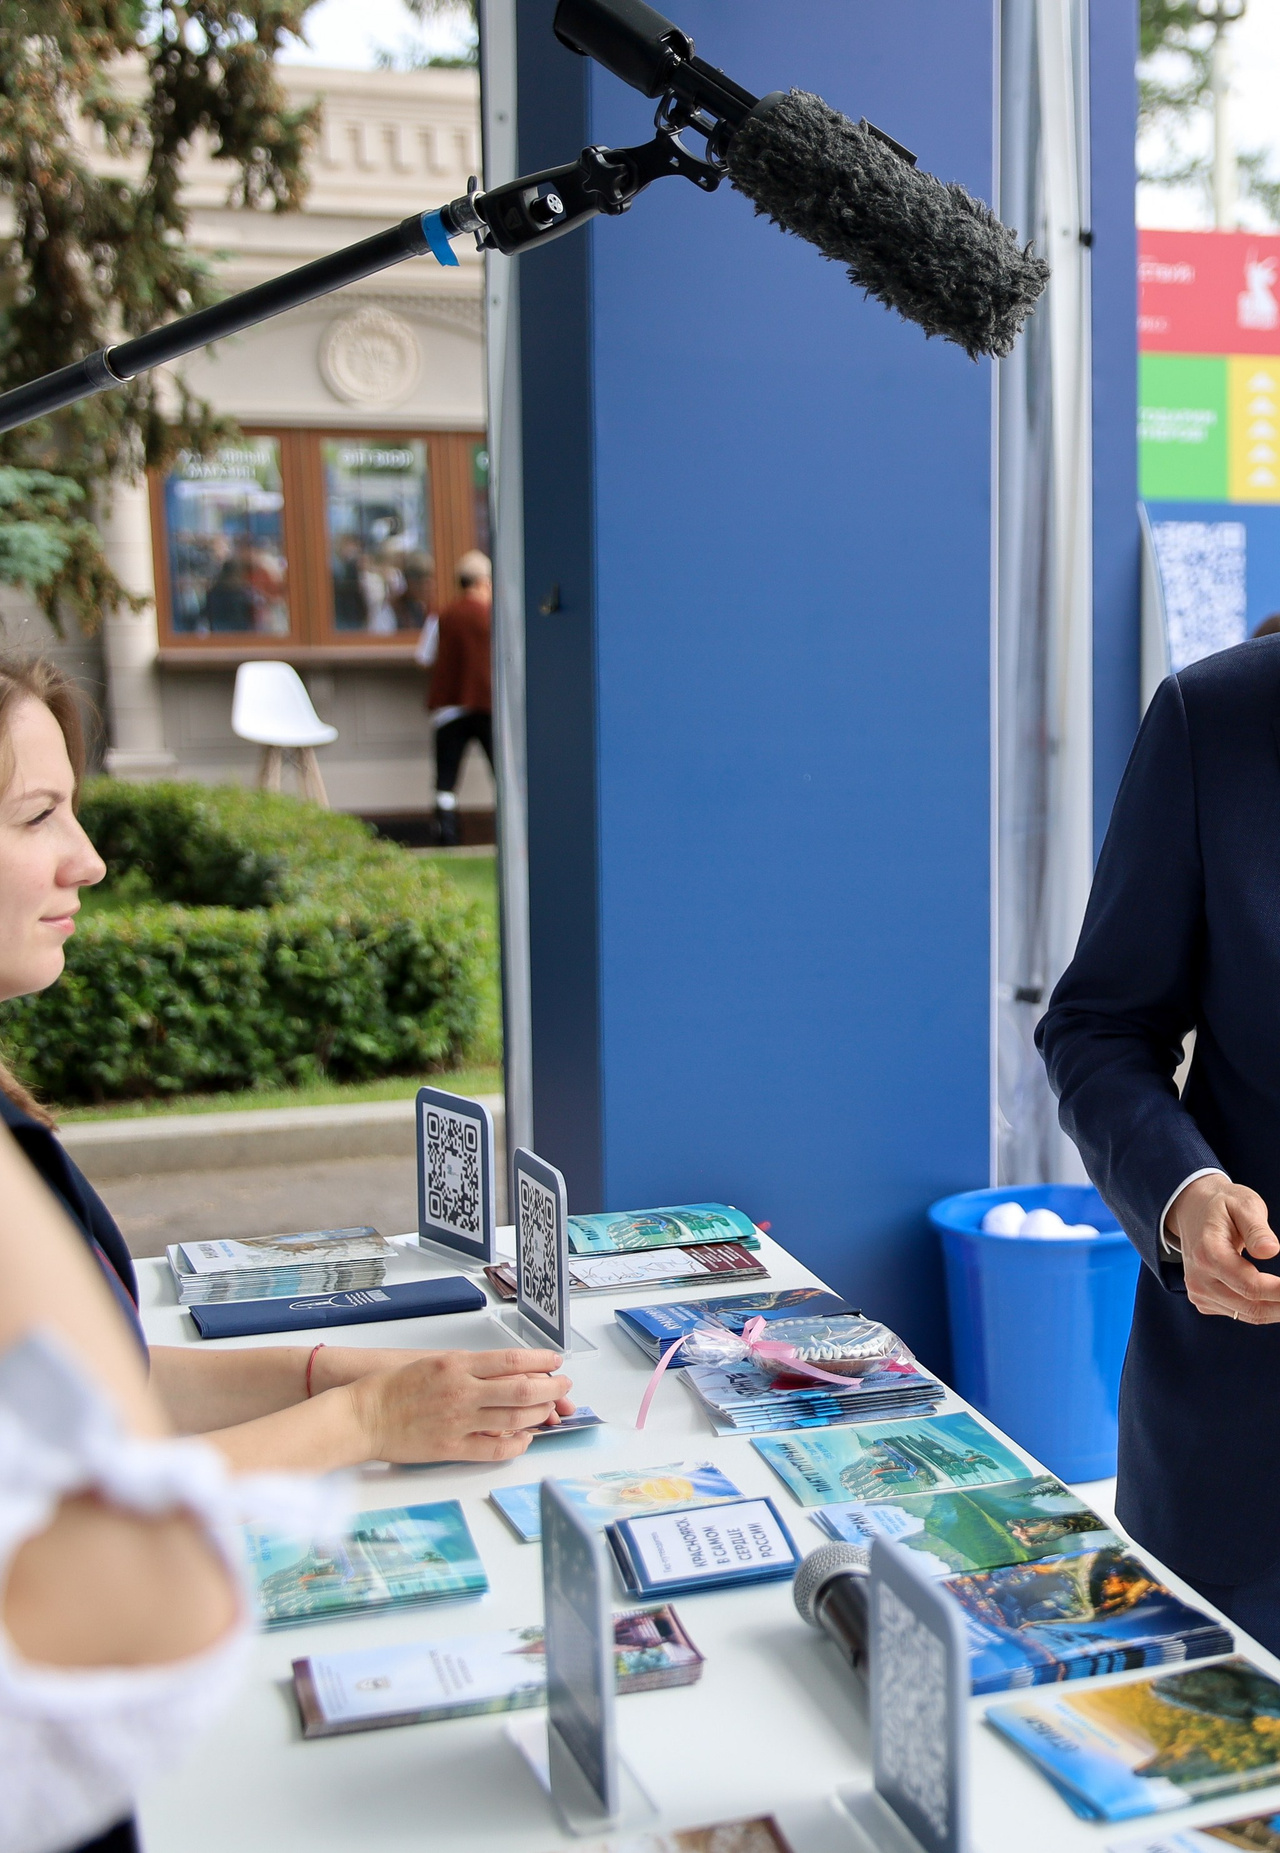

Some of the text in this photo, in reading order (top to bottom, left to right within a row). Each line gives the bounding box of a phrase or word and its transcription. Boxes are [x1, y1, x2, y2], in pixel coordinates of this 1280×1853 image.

[702, 1525, 731, 1565] В САМОМ
[726, 1527, 752, 1561] СЕРДЦЕ
[748, 1522, 775, 1558] РОССИИ
